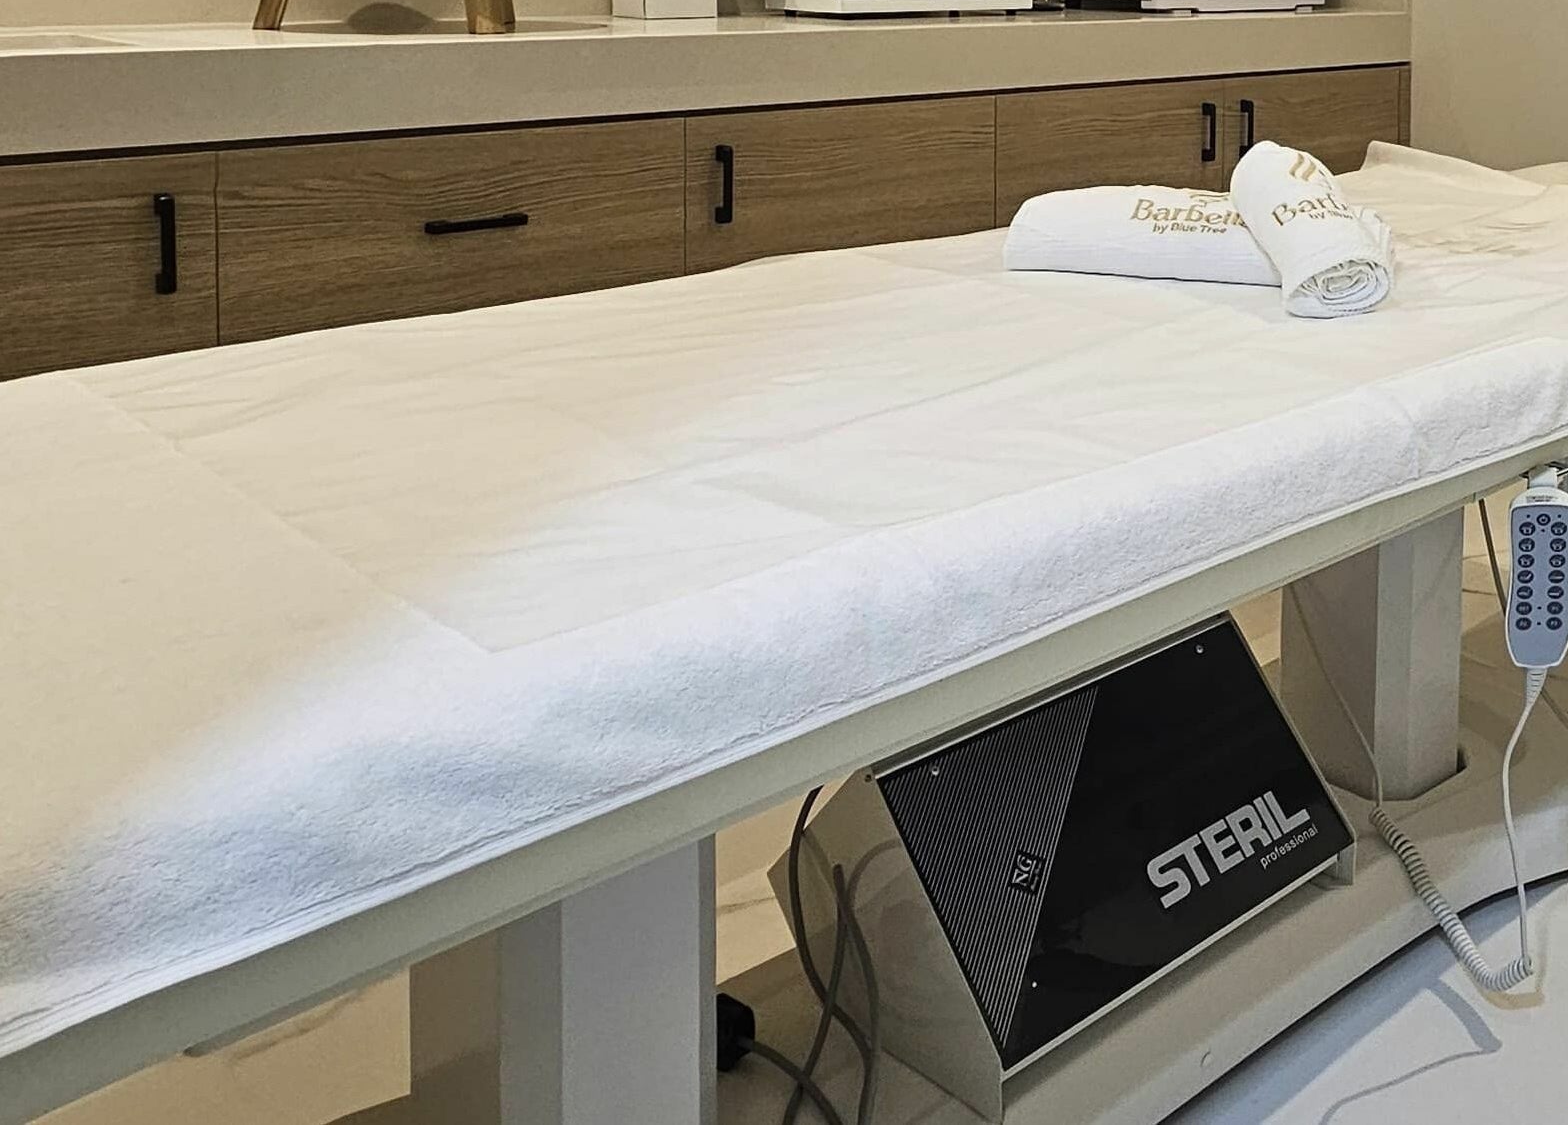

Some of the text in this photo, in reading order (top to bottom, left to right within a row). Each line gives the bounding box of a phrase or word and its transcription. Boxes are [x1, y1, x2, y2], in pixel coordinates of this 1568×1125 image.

[1153, 222, 1228, 234] by Blue Tree
[1147, 790, 1311, 909] STERIL
[1260, 823, 1319, 870] professional
